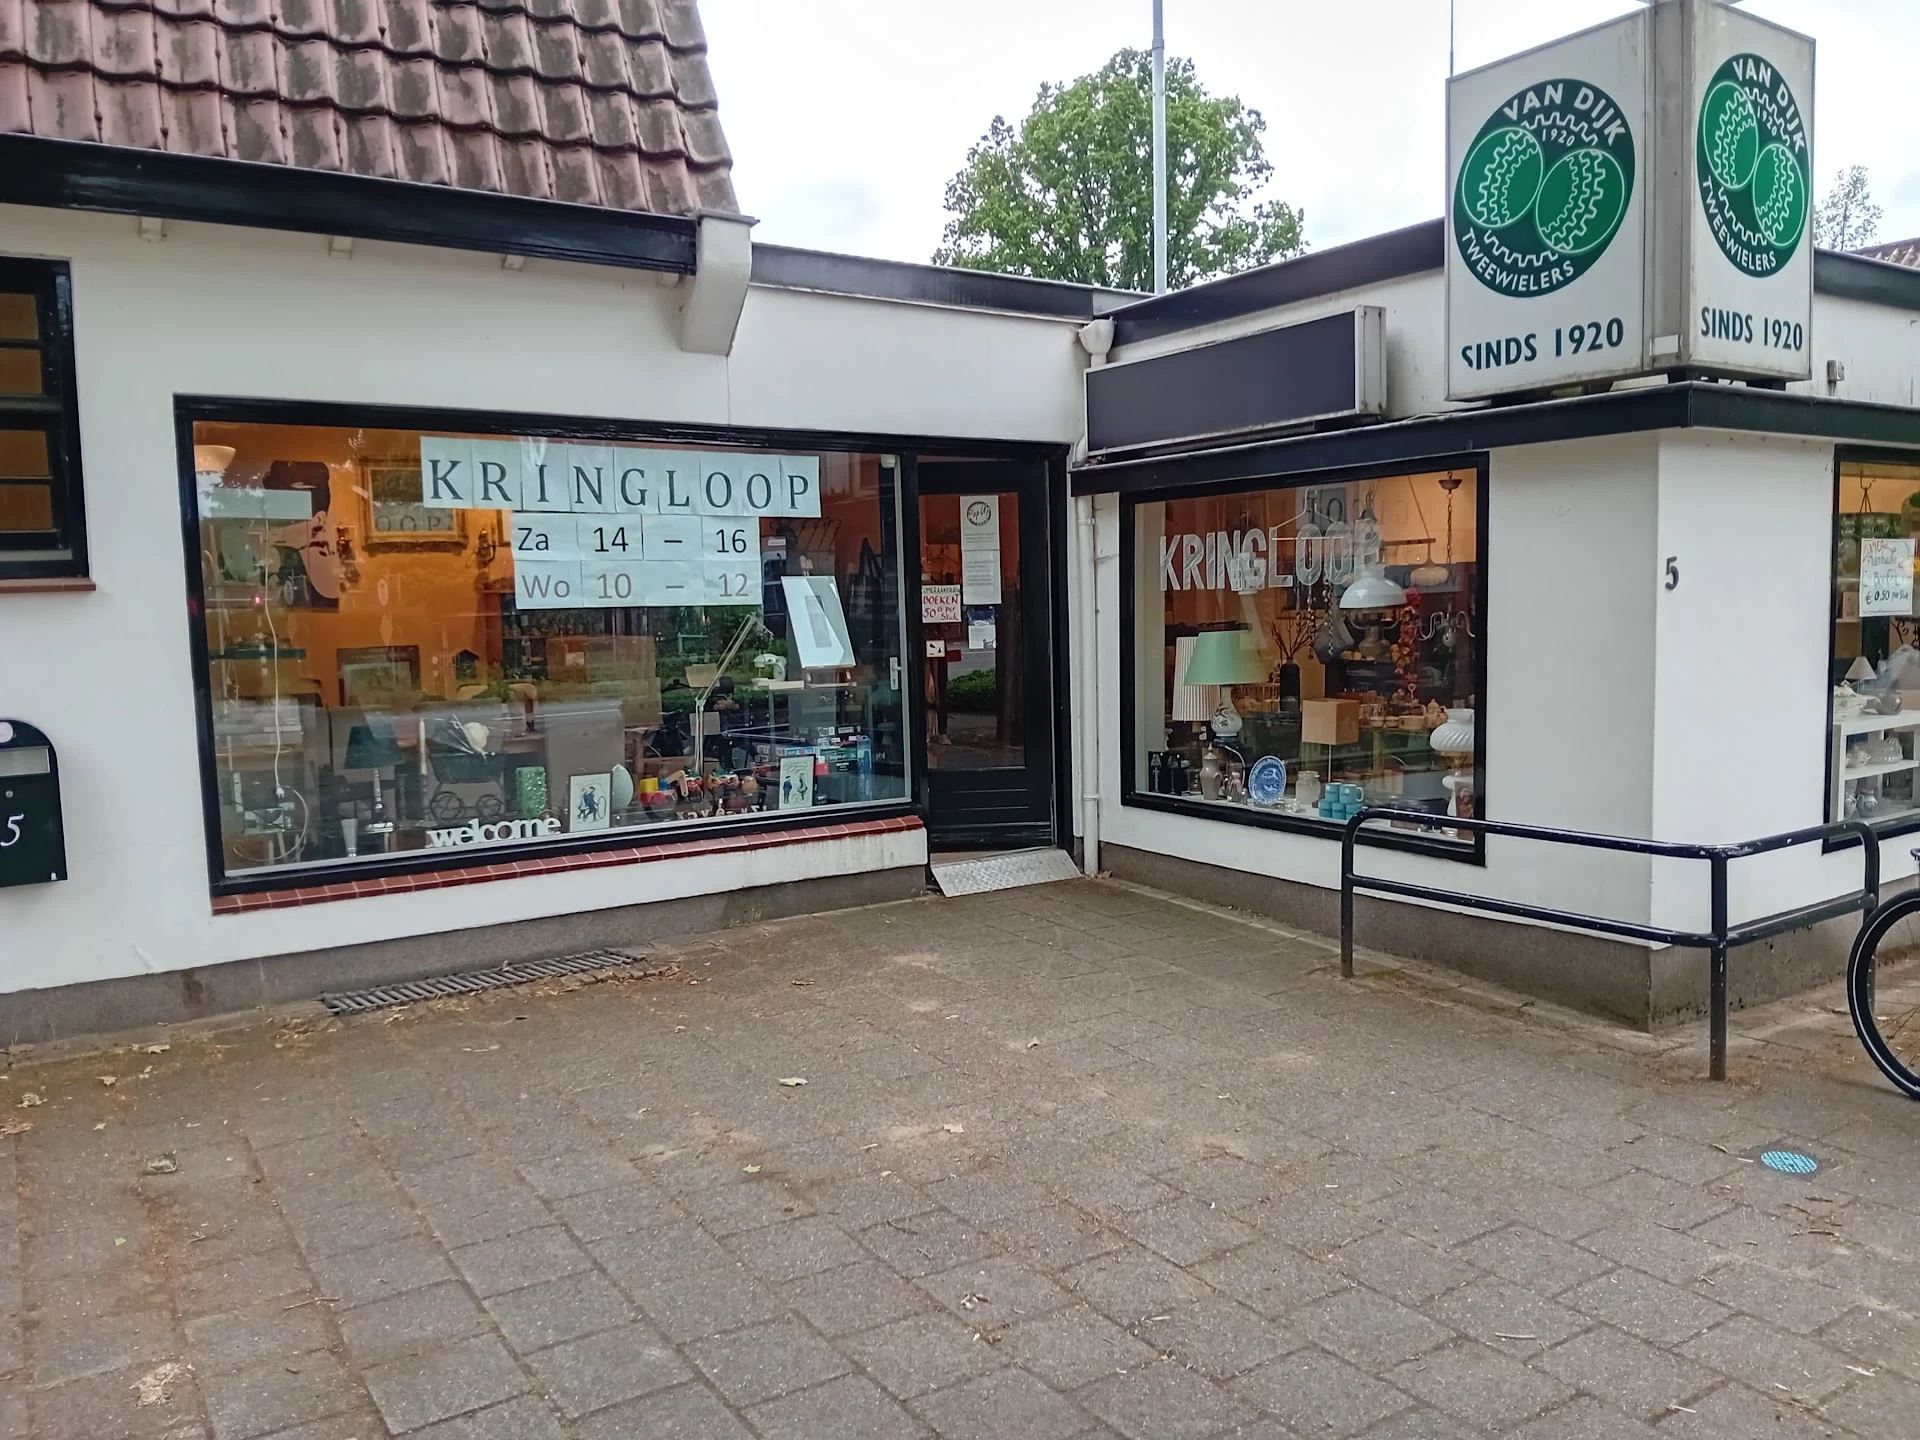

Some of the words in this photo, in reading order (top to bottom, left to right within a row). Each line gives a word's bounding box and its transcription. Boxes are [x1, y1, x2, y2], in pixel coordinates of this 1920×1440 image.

[1503, 83, 1564, 121] VAN
[1574, 88, 1626, 146] DIJK
[1732, 58, 1772, 87] VAN
[1776, 82, 1805, 154] DIJK
[1757, 105, 1778, 137] 1920
[1542, 128, 1576, 147] 1920
[1701, 177, 1777, 271] TWEEWIELERS
[1460, 227, 1574, 292] TWEEWIELERS
[1461, 333, 1538, 370] SINDS
[1554, 317, 1625, 357] 1920
[1701, 306, 1754, 344] SINDS
[1764, 318, 1803, 352] 1920
[428, 458, 810, 510] KRINGLOOP
[518, 527, 550, 552] Za
[593, 526, 629, 553] 14
[715, 528, 747, 554] 16
[522, 574, 571, 599] Wo
[597, 573, 632, 599] 10
[718, 573, 750, 598] 12
[1665, 556, 1680, 591] 5
[923, 595, 959, 605] BOEKEN
[0, 814, 25, 847] 5
[425, 818, 562, 848] welcome
